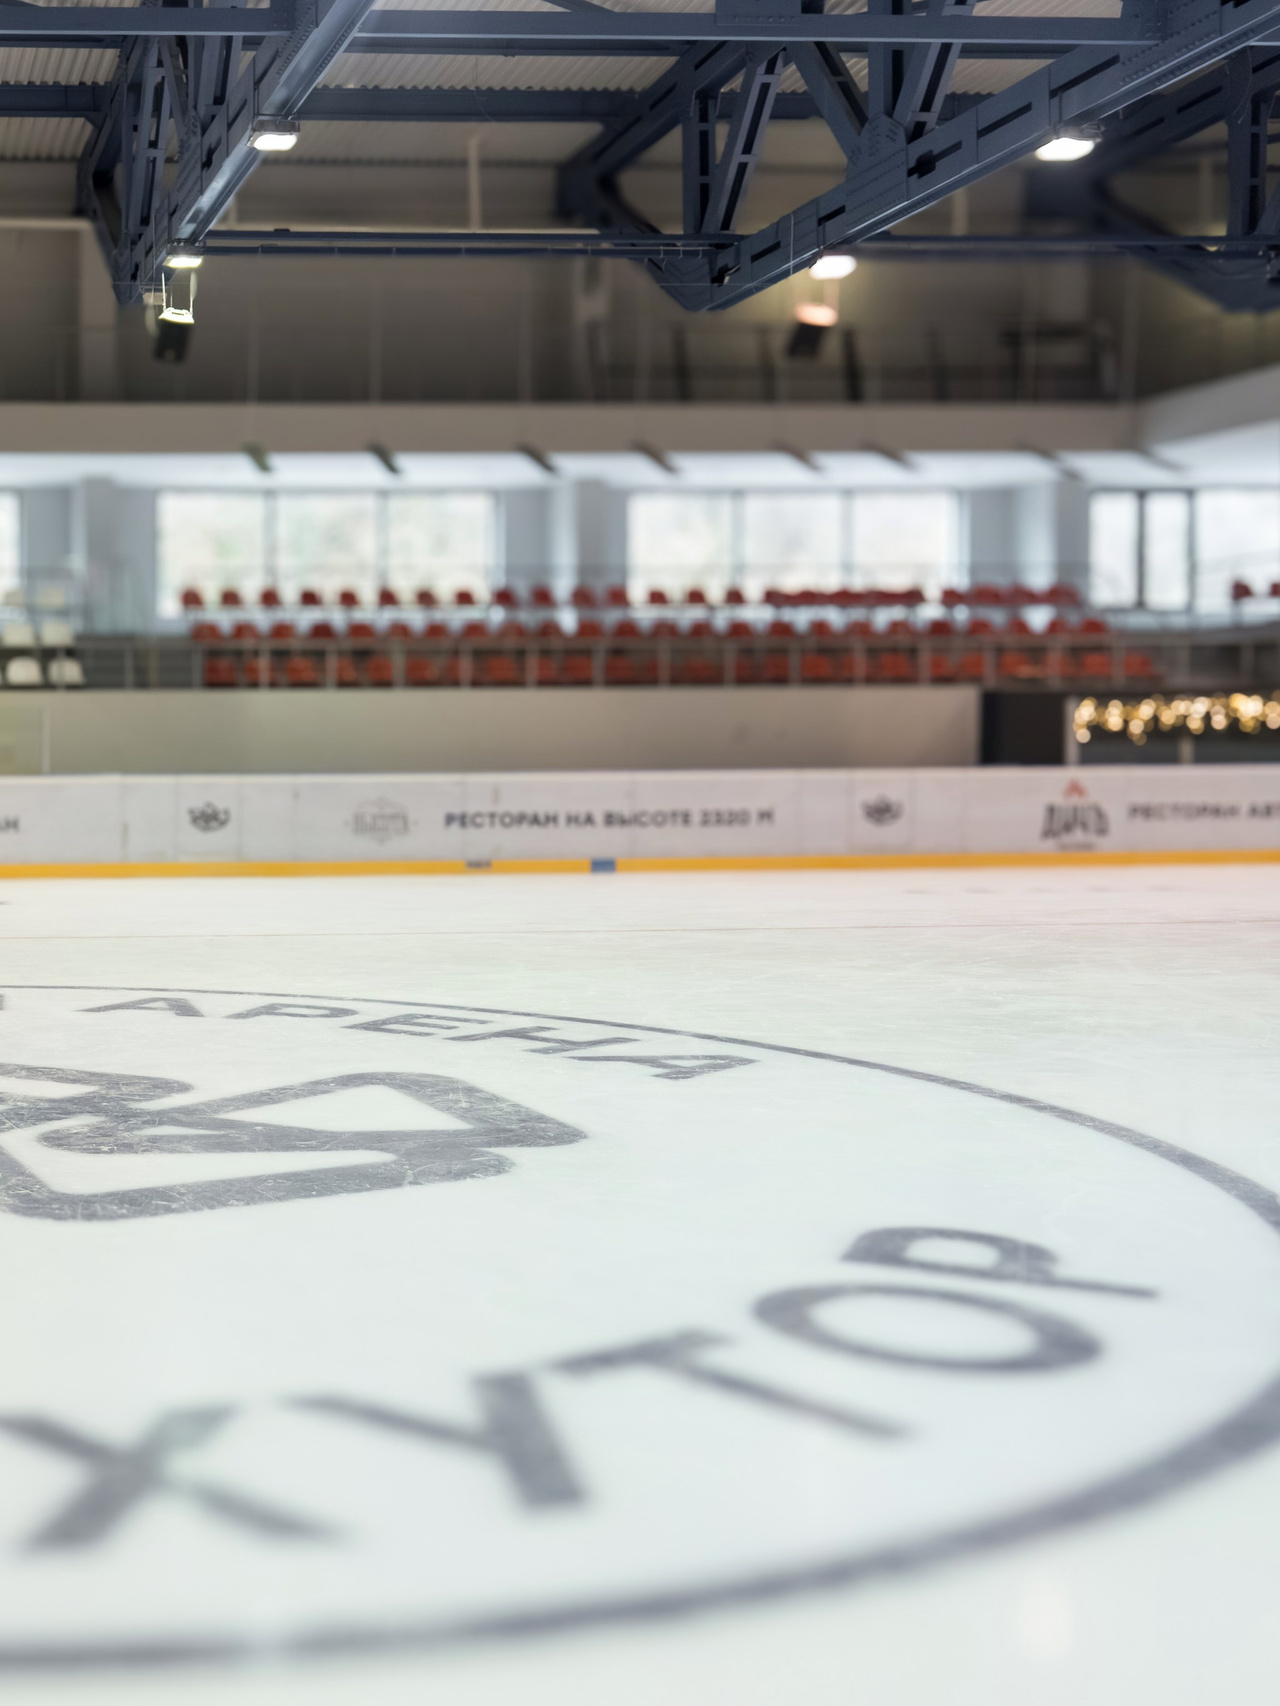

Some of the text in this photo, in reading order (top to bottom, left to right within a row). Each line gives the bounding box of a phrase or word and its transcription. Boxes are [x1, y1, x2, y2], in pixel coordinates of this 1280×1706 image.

[444, 811, 558, 829] РЕСТОРАН
[565, 810, 596, 828] НА
[604, 809, 691, 828] ВЫСОТЕ
[74, 996, 758, 1080] АРЕНА
